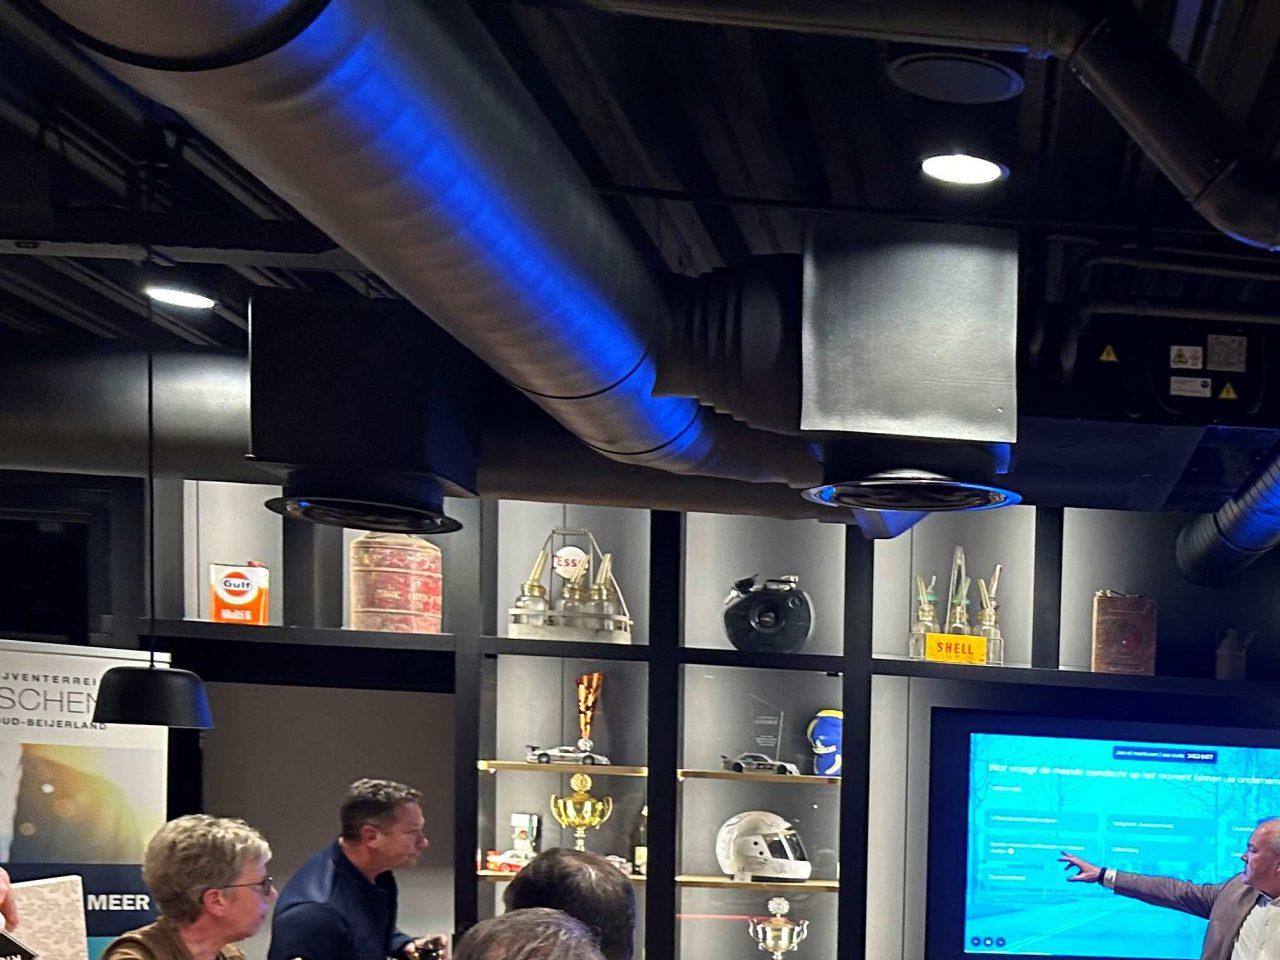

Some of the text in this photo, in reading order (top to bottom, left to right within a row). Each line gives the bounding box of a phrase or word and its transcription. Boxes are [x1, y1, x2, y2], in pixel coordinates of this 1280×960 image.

[223, 580, 251, 589] Gulf
[937, 642, 974, 656] SHELL
[0, 672, 97, 686] JVENTERREI
[0, 686, 98, 714] SCHEN
[0, 717, 107, 731] UD-BEIJERLAND
[87, 894, 150, 910] MEER
